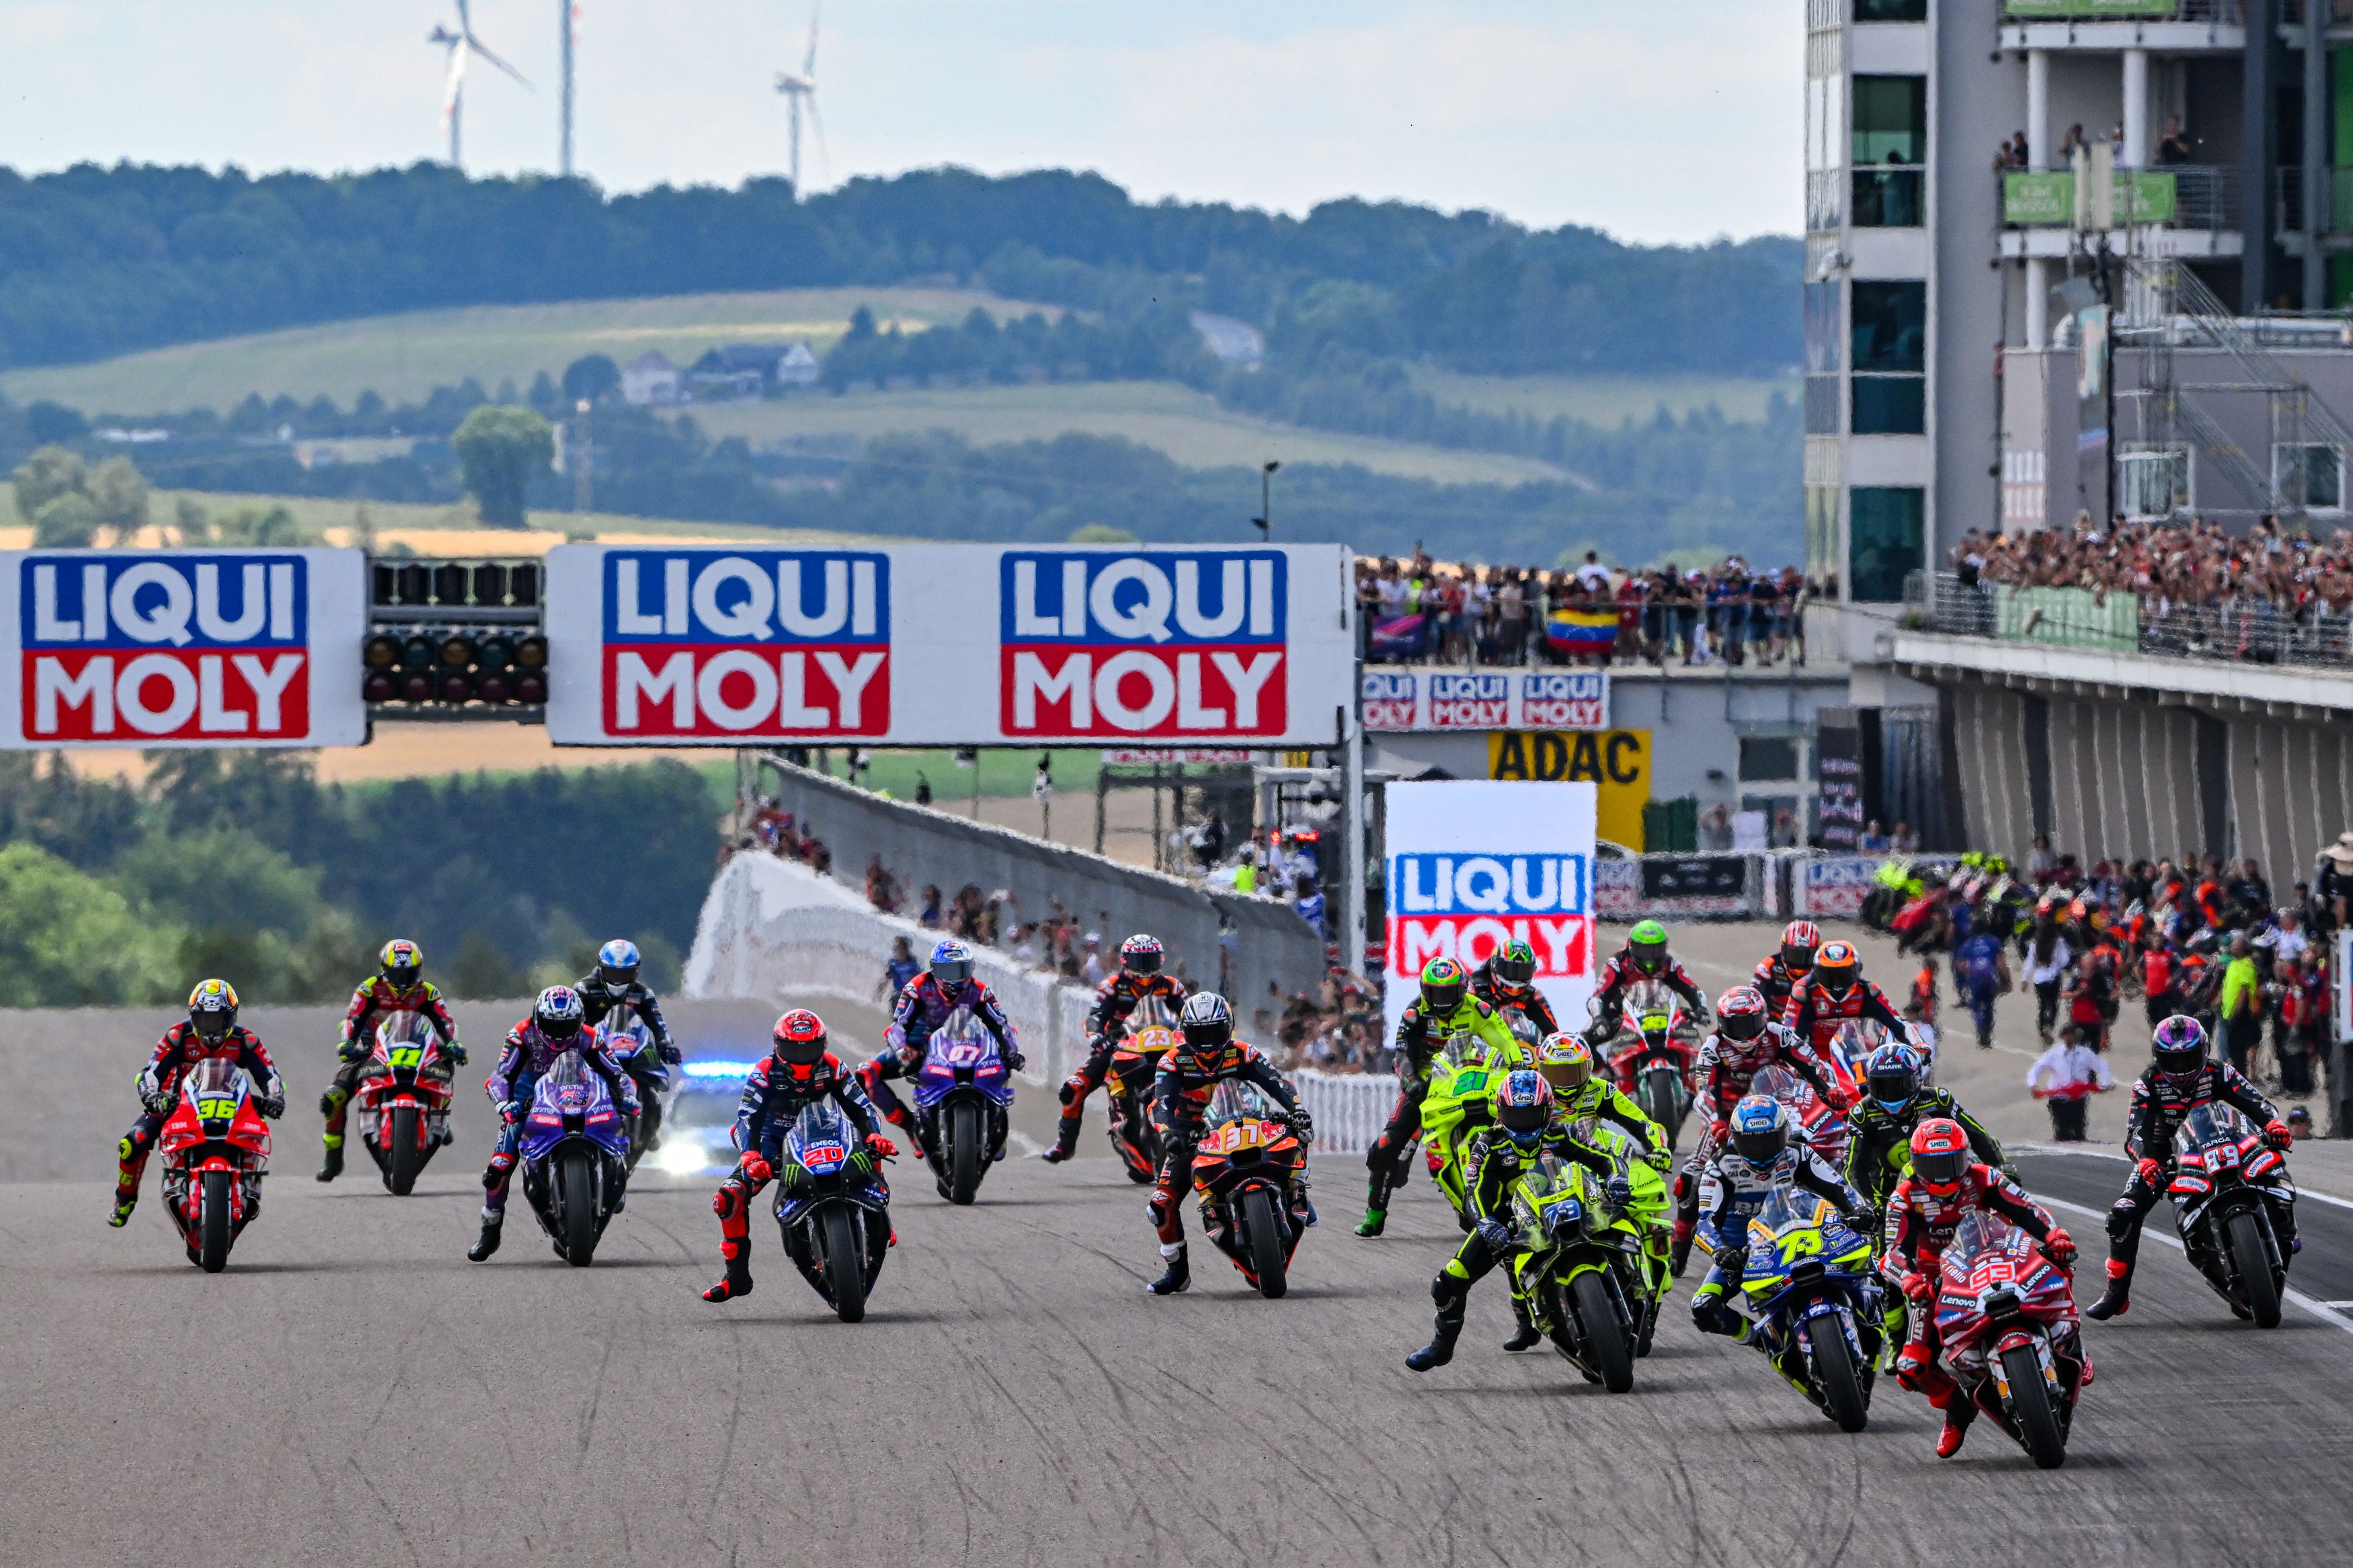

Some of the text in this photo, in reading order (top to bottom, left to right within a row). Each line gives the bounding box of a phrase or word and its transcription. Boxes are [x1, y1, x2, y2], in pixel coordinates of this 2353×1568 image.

[34, 562, 294, 645] LIQUI
[618, 556, 877, 642] LIQUI
[1014, 556, 1275, 643] LIQUI
[36, 653, 305, 734] MOLY
[616, 650, 885, 730] MOLY
[1013, 650, 1283, 730] MOLY
[1363, 676, 1413, 700] QUI
[1433, 676, 1507, 700] LIQUI
[1525, 676, 1600, 700] LIQUI
[1363, 701, 1414, 725] OLY
[1434, 701, 1507, 725] MOLY
[1527, 701, 1601, 725] MOLY
[1494, 731, 1640, 784] ADAC
[1403, 858, 1577, 913] LIQUI
[1142, 1029, 1171, 1048] 23
[387, 1048, 423, 1067] 11
[949, 1044, 982, 1062] 07
[982, 1059, 1001, 1067] prima
[1222, 1058, 1240, 1069] KTM
[1520, 1047, 1535, 1065] 3
[1852, 1061, 1867, 1085] 1
[1452, 1071, 1489, 1098] 21
[1513, 1094, 1533, 1102] Arai
[196, 1099, 237, 1121] 36
[532, 1106, 555, 1114] prima
[590, 1115, 610, 1123] MOTUL
[592, 1104, 613, 1115] prima
[1808, 1110, 1833, 1132] Lenovo
[810, 1140, 840, 1149] ENEOS
[1226, 1124, 1259, 1151] 37
[1929, 1141, 1948, 1149] SHOEI
[803, 1145, 845, 1167] 20
[2204, 1144, 2240, 1175] 89
[2248, 1153, 2272, 1176] sterilgarda
[2270, 1167, 2284, 1176] sky
[2177, 1178, 2206, 1191] sterilgarda
[1960, 1204, 1975, 1213] SHOEI
[1823, 1225, 1841, 1235] Estrella
[1776, 1229, 1824, 1268] 73
[2020, 1237, 2032, 1257] riello
[1945, 1266, 1966, 1284] riello
[1970, 1262, 2016, 1293] 93
[2021, 1265, 2050, 1290] Lenovo
[1942, 1295, 1976, 1307] Lenovo
[1948, 1312, 1962, 1321] TIM
